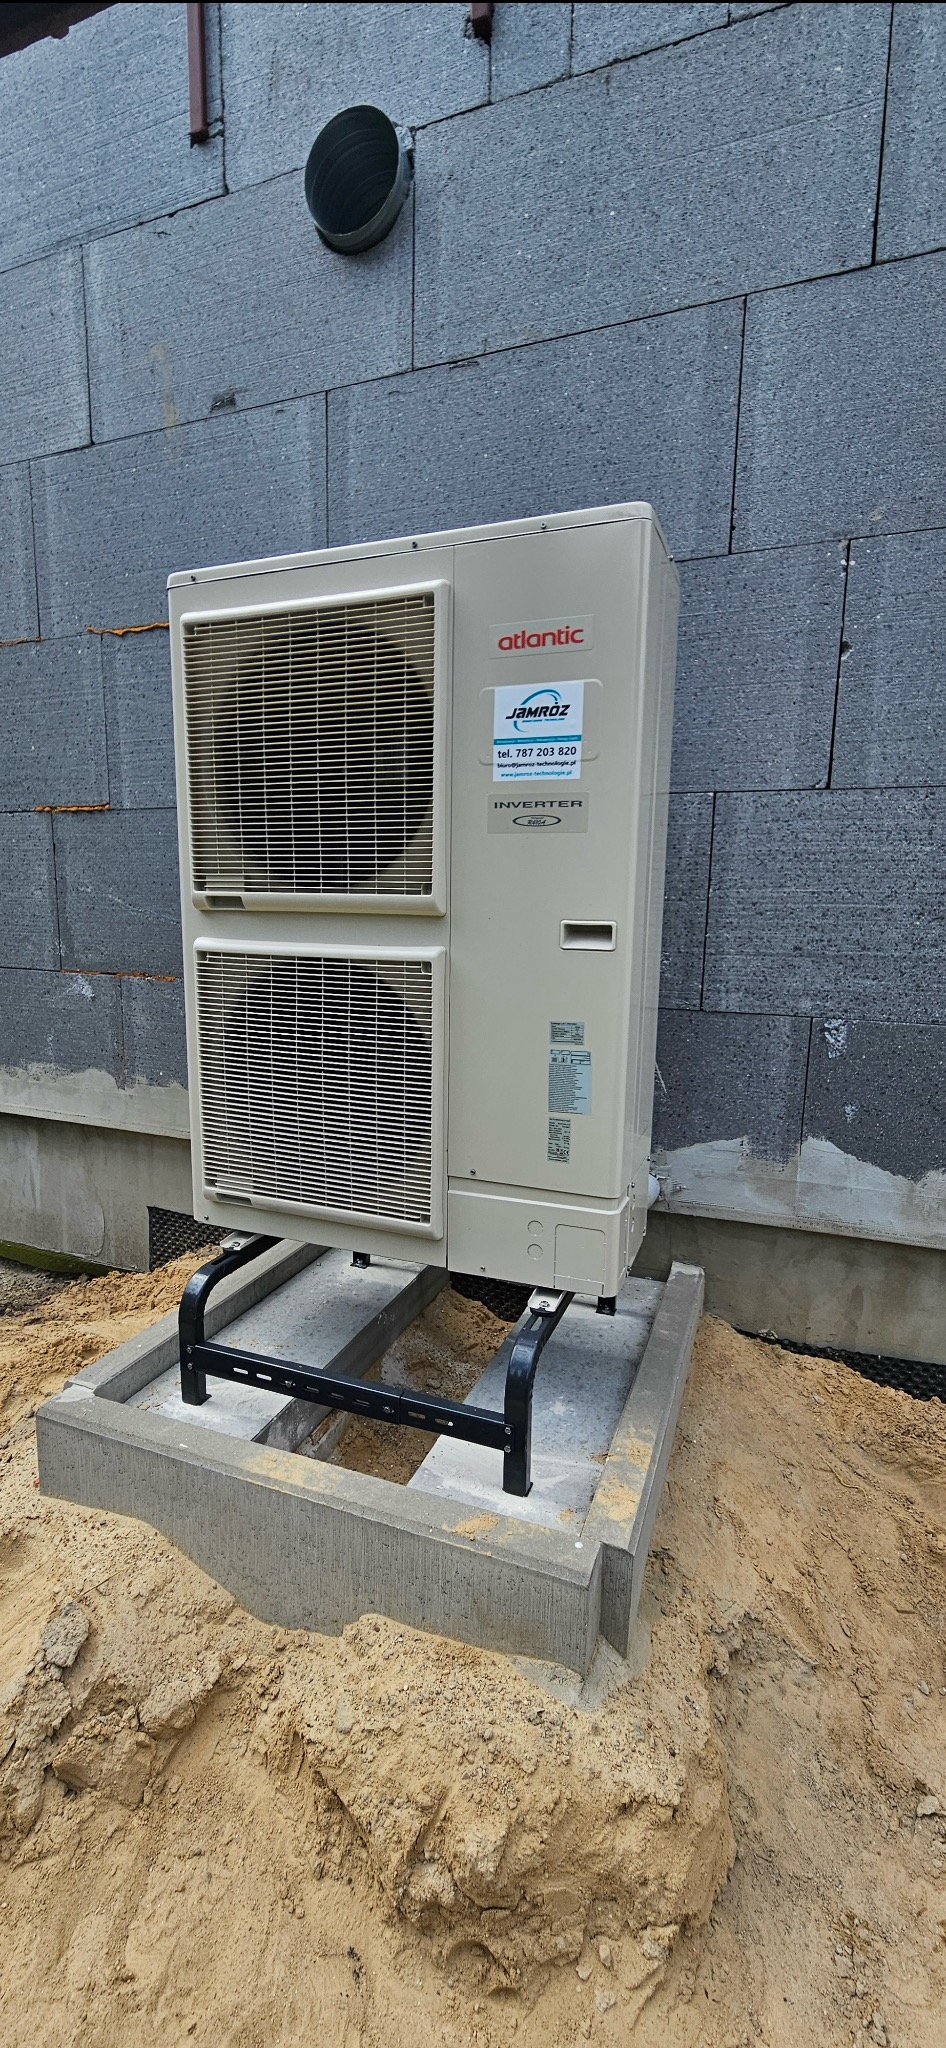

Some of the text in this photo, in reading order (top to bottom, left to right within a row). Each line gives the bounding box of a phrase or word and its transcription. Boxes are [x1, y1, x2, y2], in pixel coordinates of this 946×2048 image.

[498, 625, 584, 651] atlantic
[497, 746, 577, 759] tel. 787 203 820
[497, 760, 577, 769] biuro@jamroz-technologie.pl
[500, 769, 573, 778] www.jamroz-technologie.pl
[494, 800, 583, 809] INVERTER
